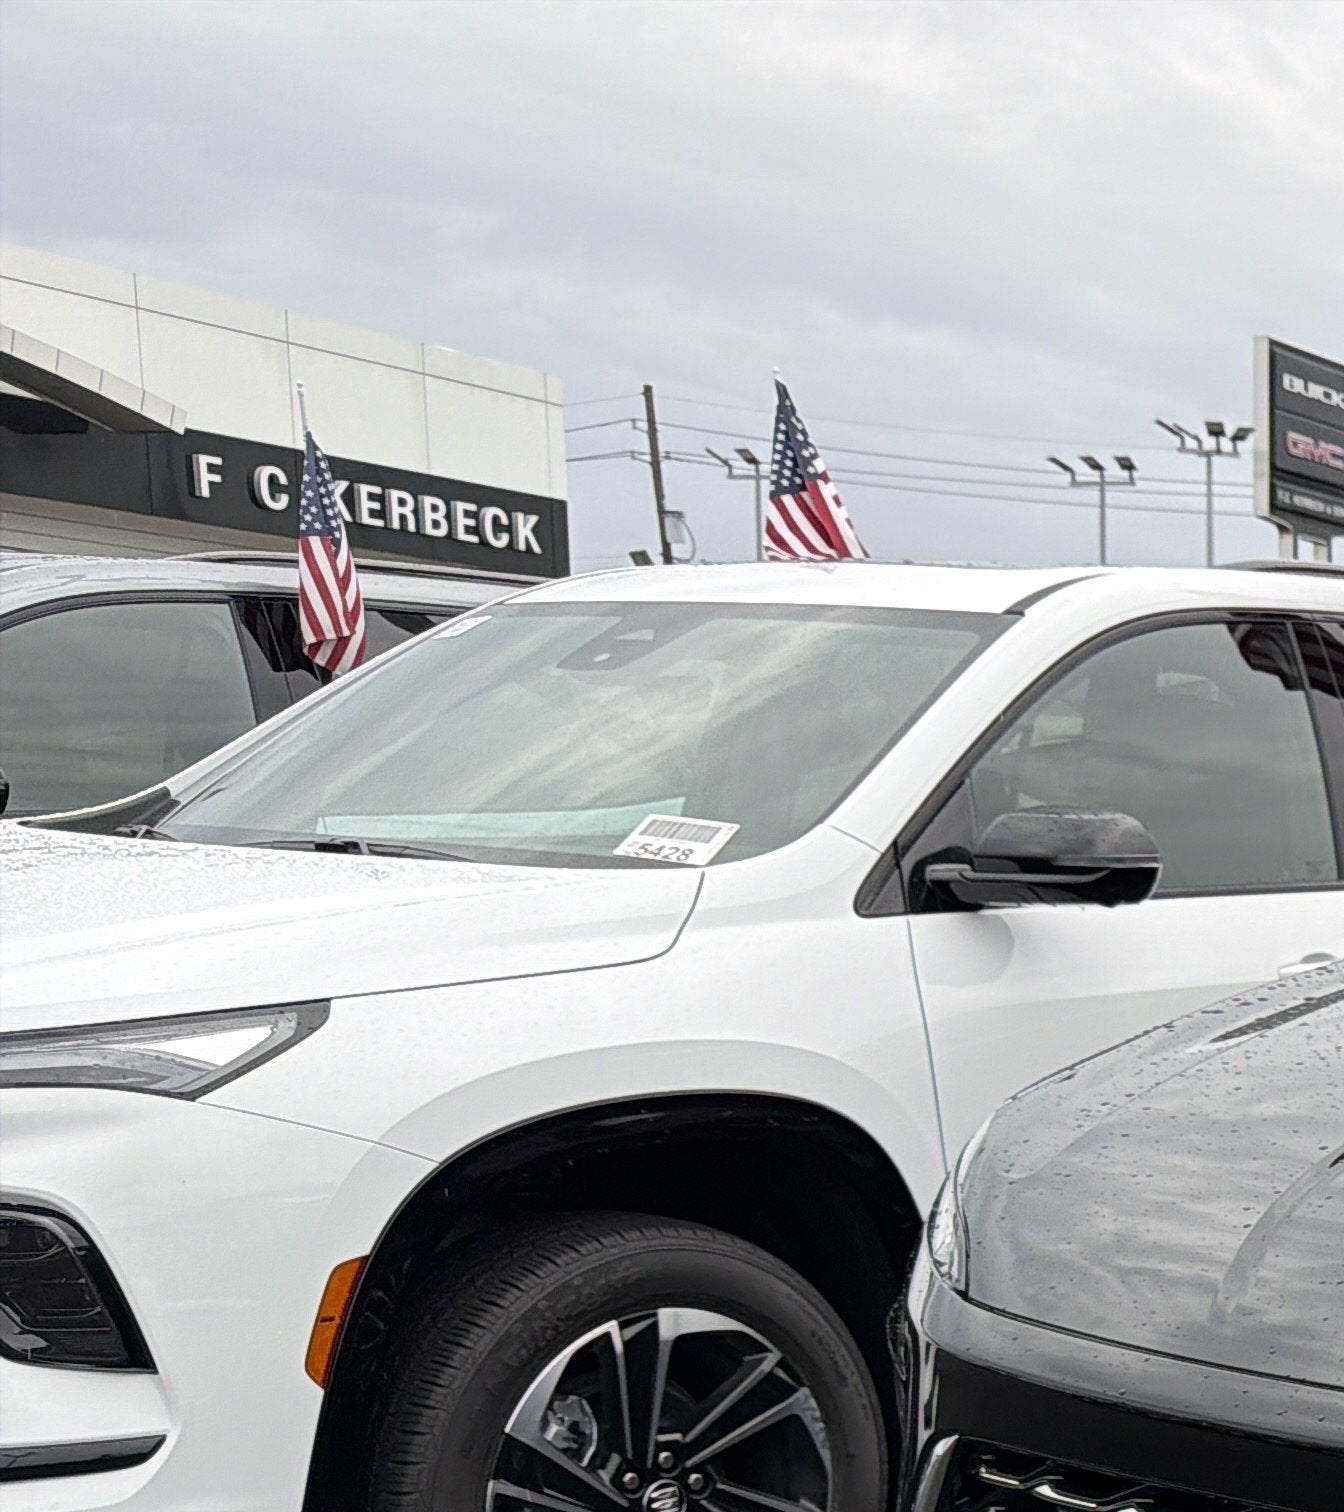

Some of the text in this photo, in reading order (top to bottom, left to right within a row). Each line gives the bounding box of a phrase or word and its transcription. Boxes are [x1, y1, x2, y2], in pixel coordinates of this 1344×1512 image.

[1286, 430, 1344, 471] GMC
[192, 453, 223, 499] F
[253, 465, 290, 511] C
[633, 843, 695, 861] 5428
